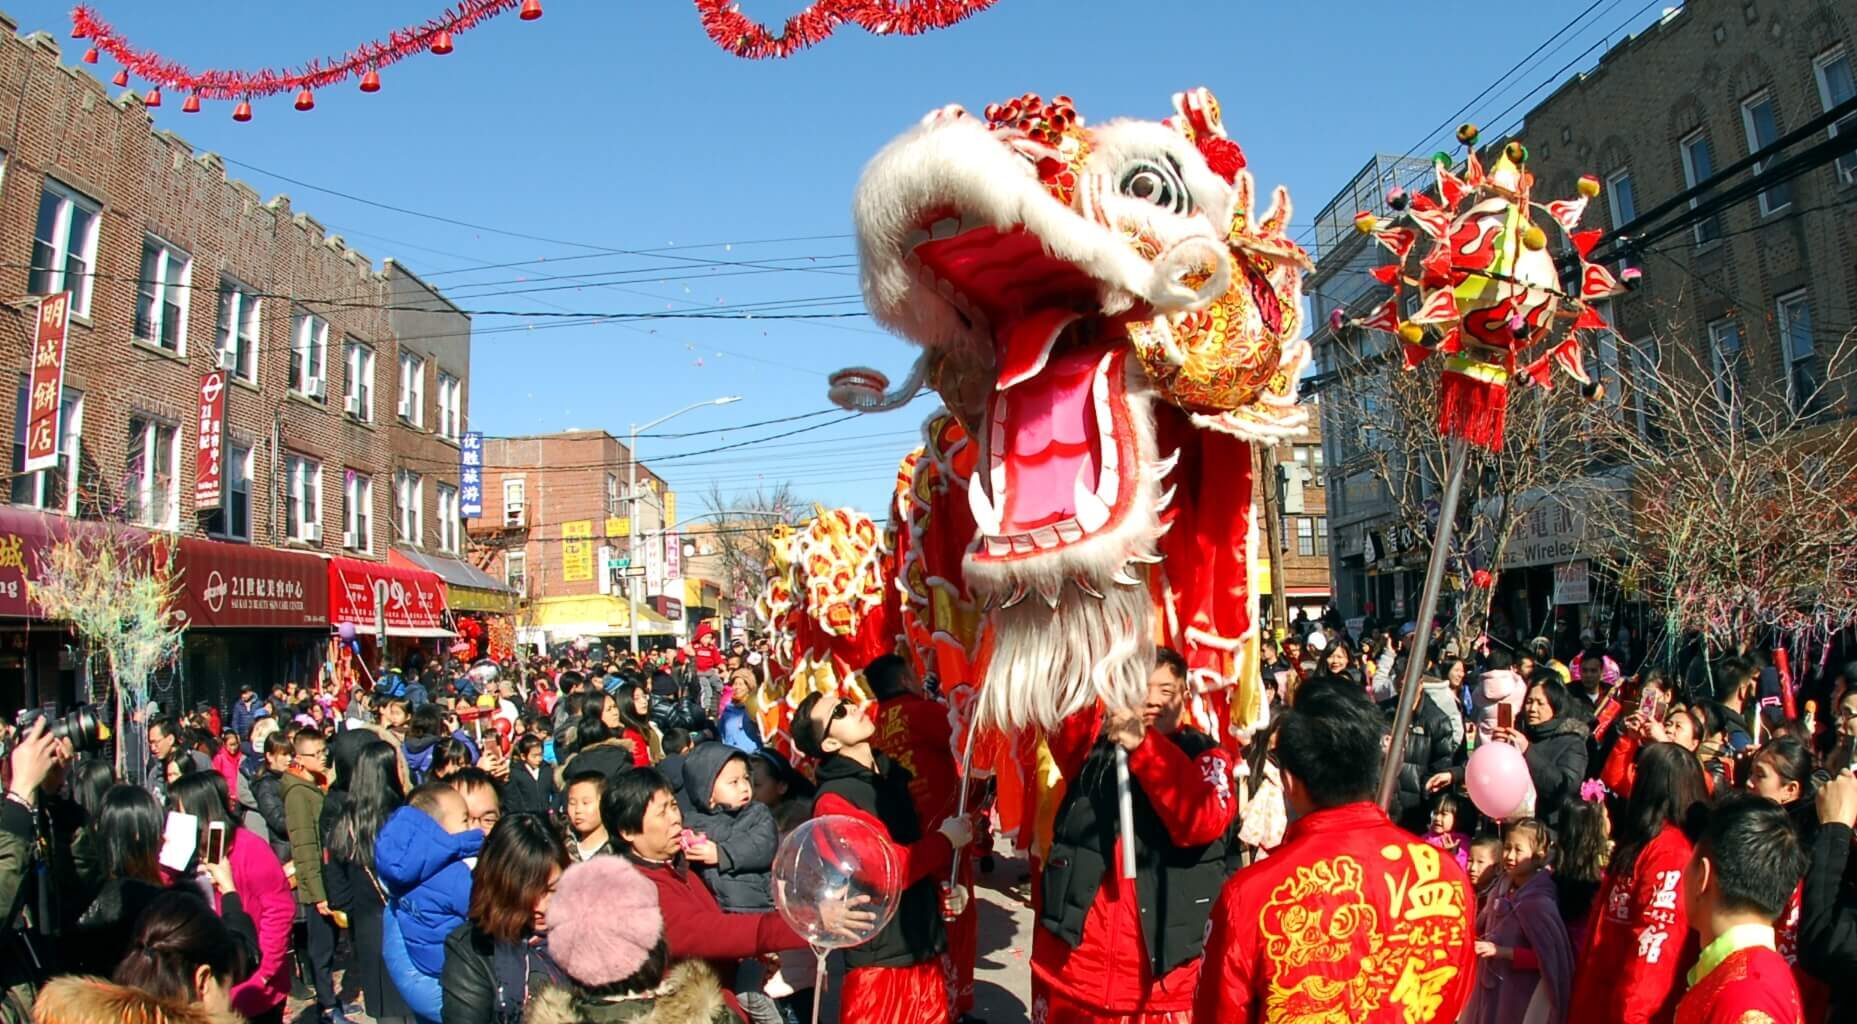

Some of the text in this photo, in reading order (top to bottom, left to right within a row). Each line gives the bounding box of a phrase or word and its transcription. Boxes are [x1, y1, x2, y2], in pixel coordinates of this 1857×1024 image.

[31, 298, 65, 451] 明城餅店
[1525, 540, 1583, 562] Wireless
